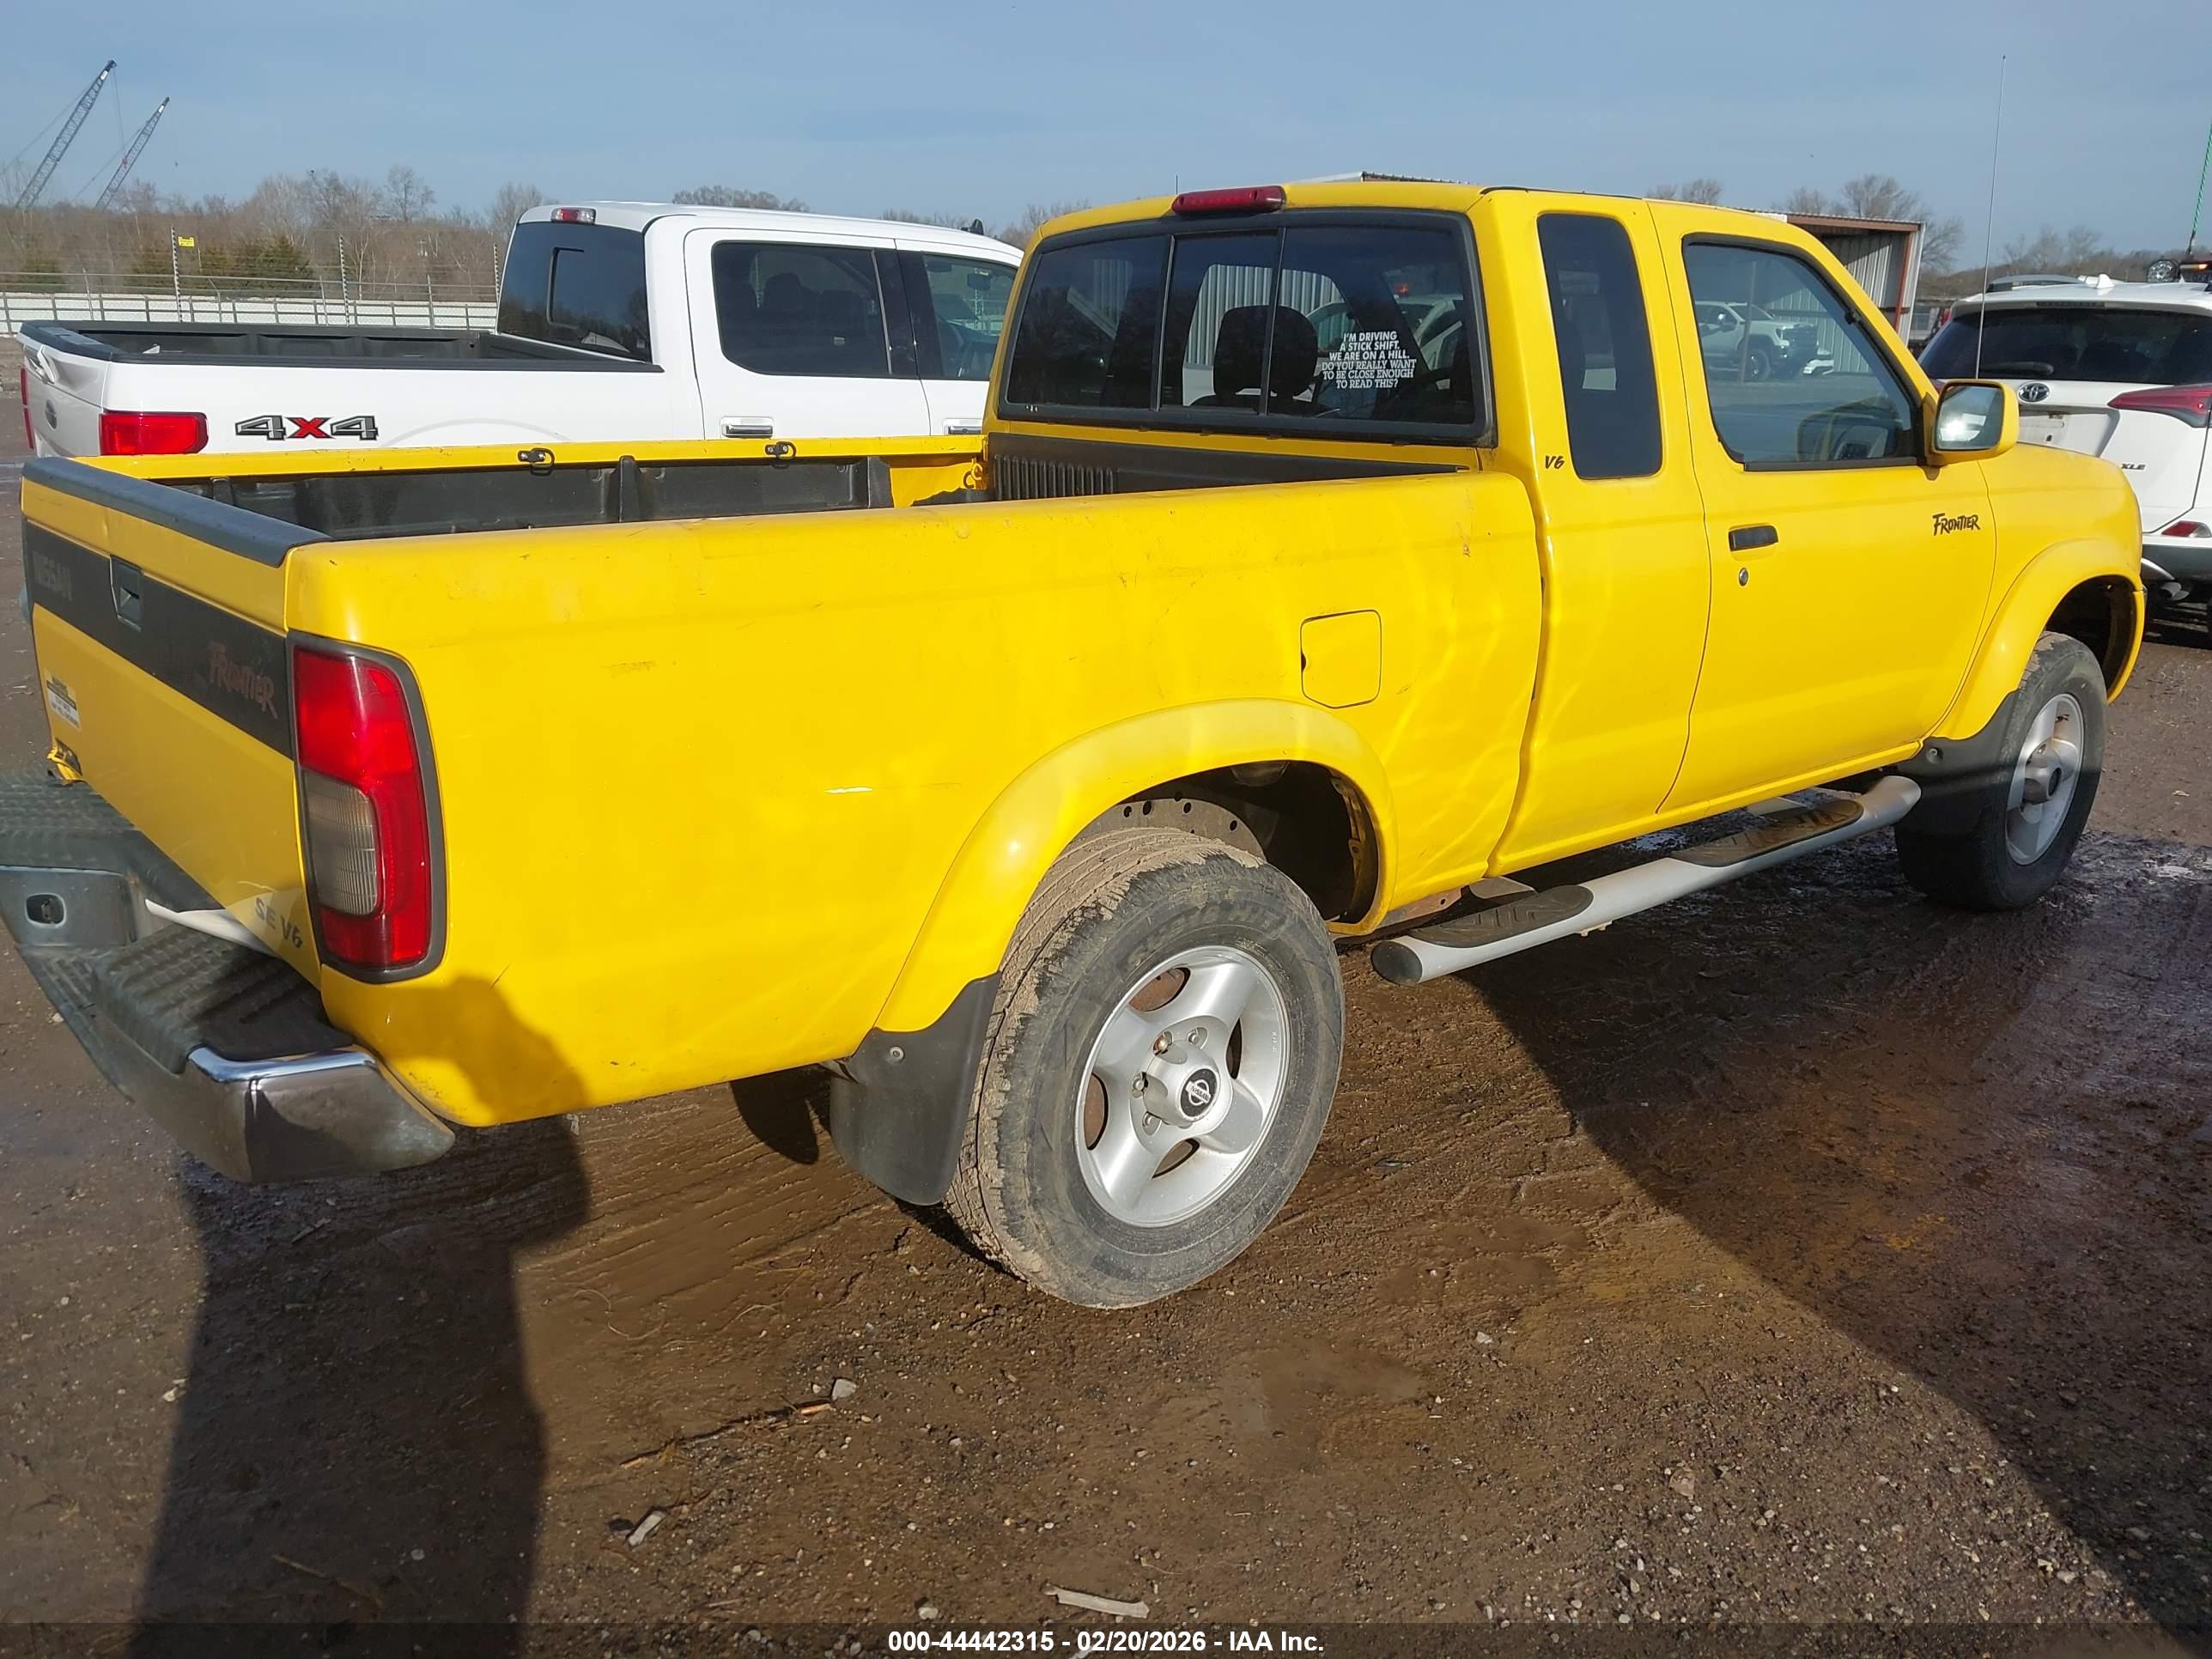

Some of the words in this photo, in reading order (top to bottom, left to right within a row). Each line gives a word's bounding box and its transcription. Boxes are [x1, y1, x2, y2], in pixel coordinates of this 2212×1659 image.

[1343, 332, 1357, 342] I'M
[1358, 331, 1397, 342] DRIVING
[1340, 343, 1346, 351] A
[1347, 342, 1372, 351] STICK
[1374, 340, 1400, 350] SHIFT.
[1329, 352, 1342, 361] WE
[1344, 351, 1360, 361] ARE
[1362, 351, 1377, 360] ON
[1379, 350, 1385, 360] A
[1388, 349, 1410, 359] HILL.
[1322, 362, 1334, 371] DO
[1336, 361, 1354, 370] YOU
[1356, 360, 1388, 370] REALLY
[1390, 359, 1417, 368] WANT
[1322, 370, 1334, 380] TO
[1336, 370, 1346, 379] BE
[1348, 369, 1374, 379] CLOSE
[1376, 368, 1414, 378] ENOUGH
[1336, 380, 1347, 389] TO
[1349, 379, 1372, 389] READ
[1375, 378, 1399, 388] THIS?
[1545, 454, 1565, 470] V6
[255, 896, 276, 930] SE
[280, 915, 303, 949] V6
